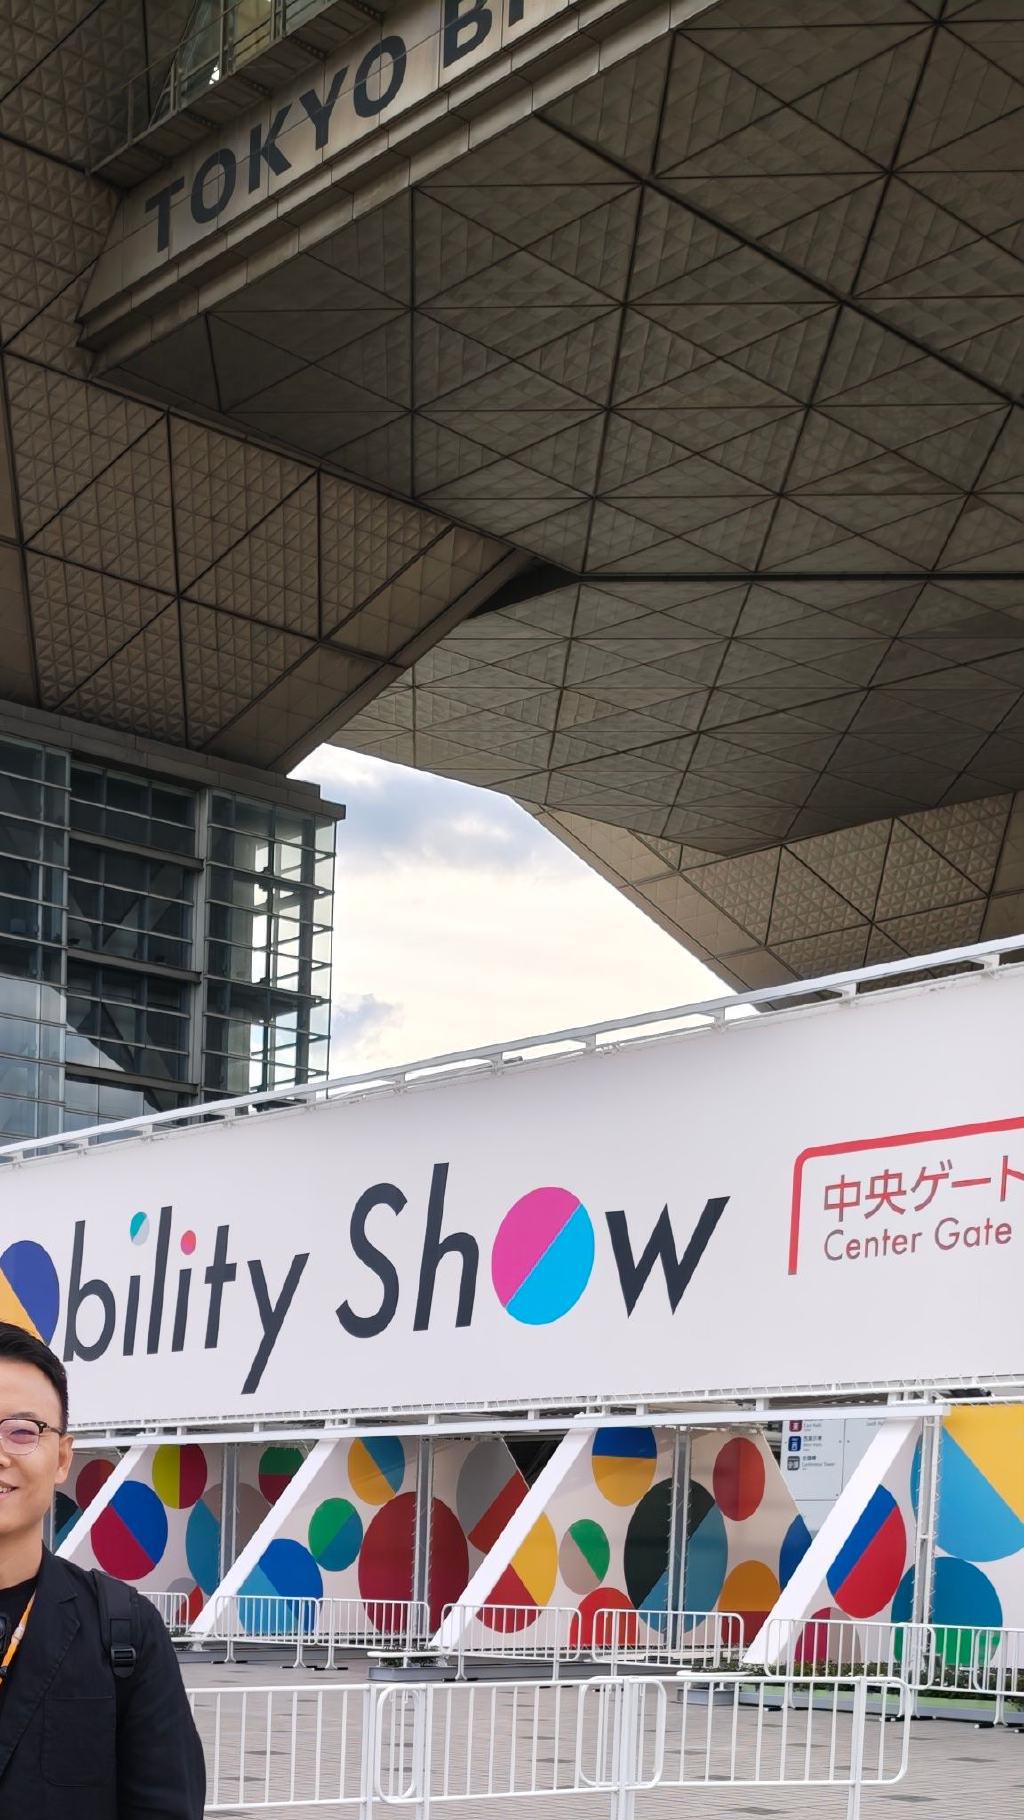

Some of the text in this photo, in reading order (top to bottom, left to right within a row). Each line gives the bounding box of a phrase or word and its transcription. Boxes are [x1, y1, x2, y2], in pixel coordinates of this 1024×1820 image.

[145, 35, 407, 252] TOKYO
[824, 1155, 1024, 1222] 中央ゲート
[824, 1217, 1012, 1261] Center Gate
[335, 1162, 731, 1339] Show
